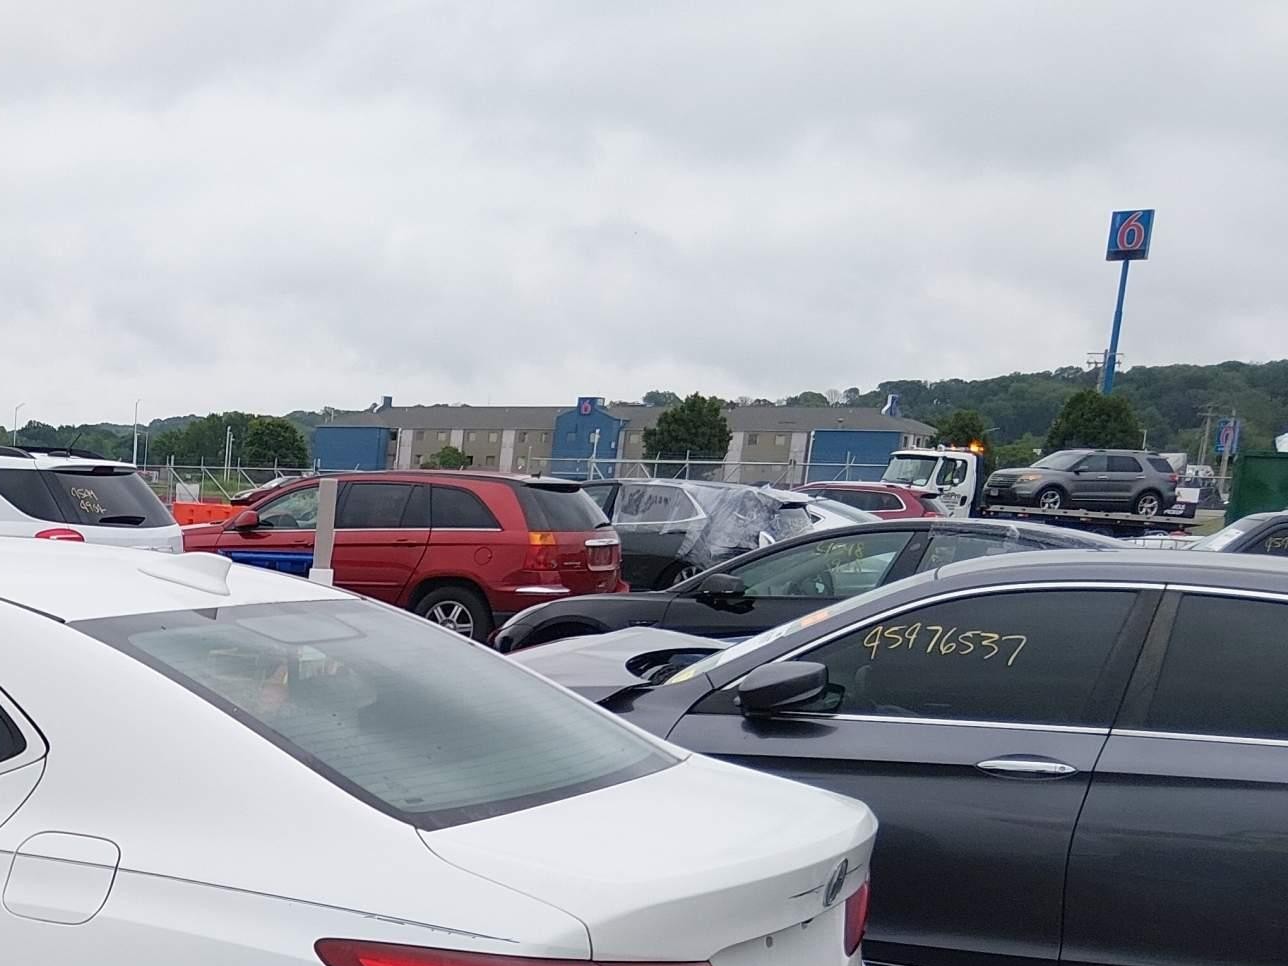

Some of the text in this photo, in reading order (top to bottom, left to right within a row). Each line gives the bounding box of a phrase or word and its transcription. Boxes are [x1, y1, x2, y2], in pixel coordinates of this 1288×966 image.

[1117, 211, 1144, 250] 6
[580, 400, 592, 415] 6
[863, 622, 1027, 666] 45476537
